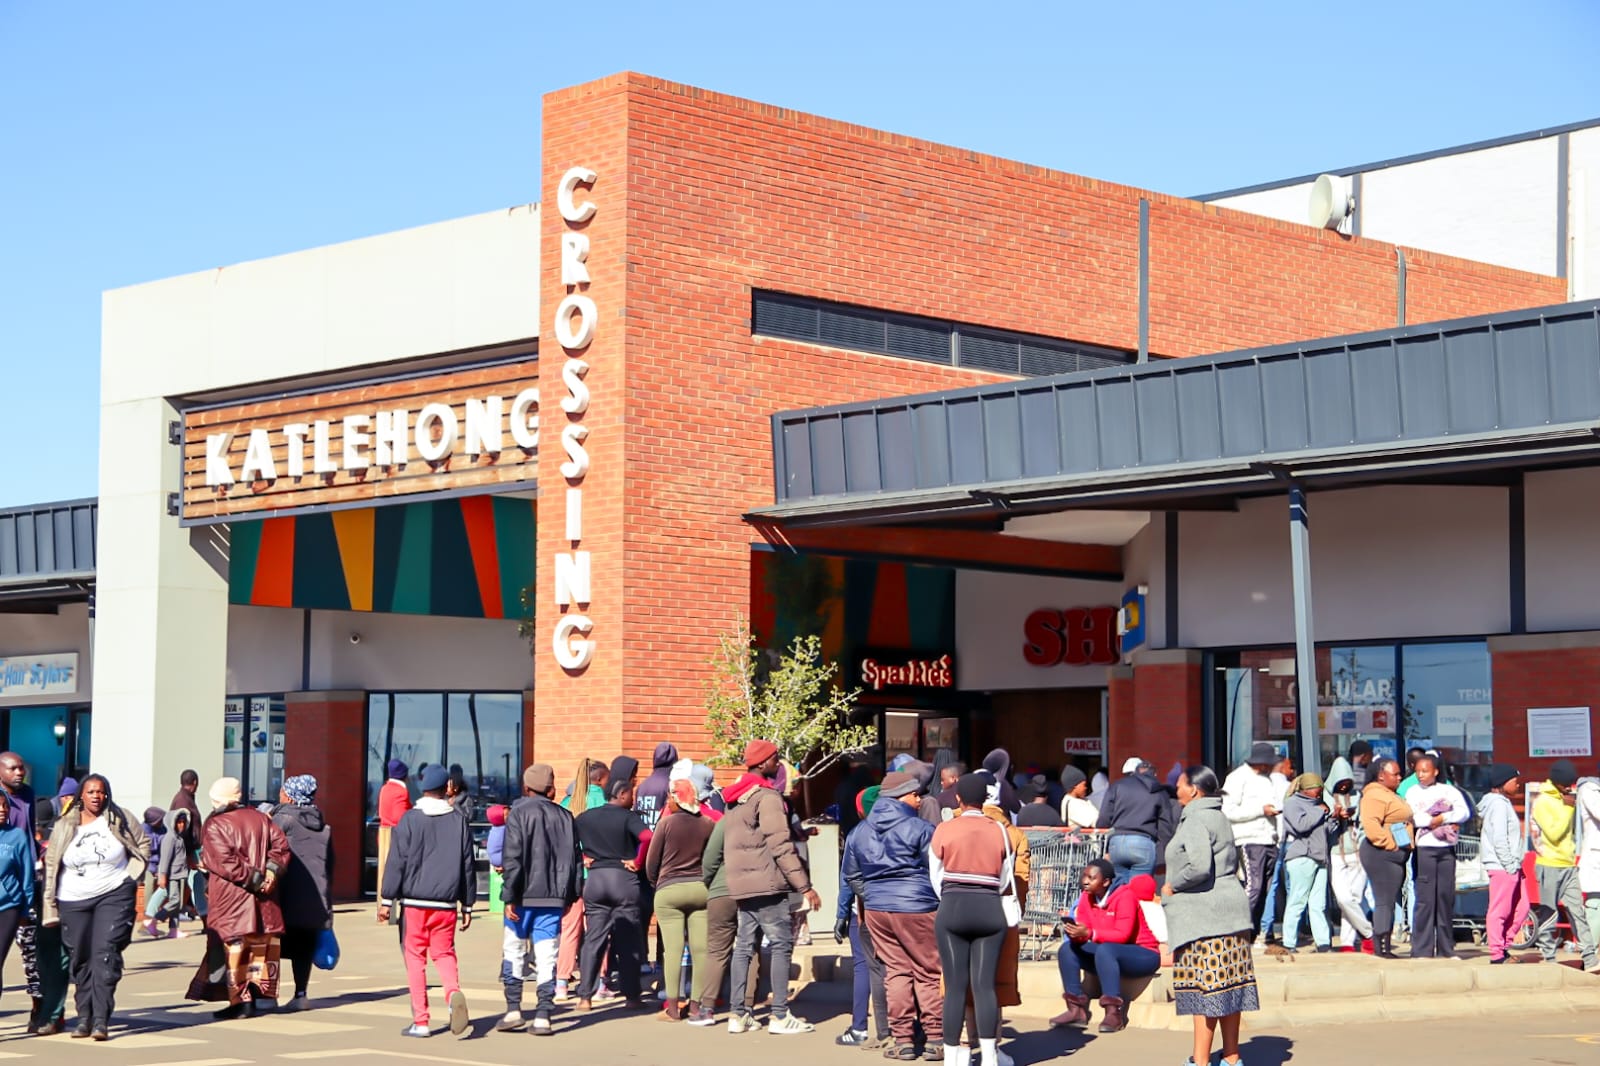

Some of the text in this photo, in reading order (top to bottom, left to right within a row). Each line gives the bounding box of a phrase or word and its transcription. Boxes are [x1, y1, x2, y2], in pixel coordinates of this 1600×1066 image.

[205, 387, 539, 487] KATLEHONG
[552, 165, 598, 670] CROSSING
[1023, 606, 1120, 666] SH
[1286, 679, 1392, 699] CLLULAR
